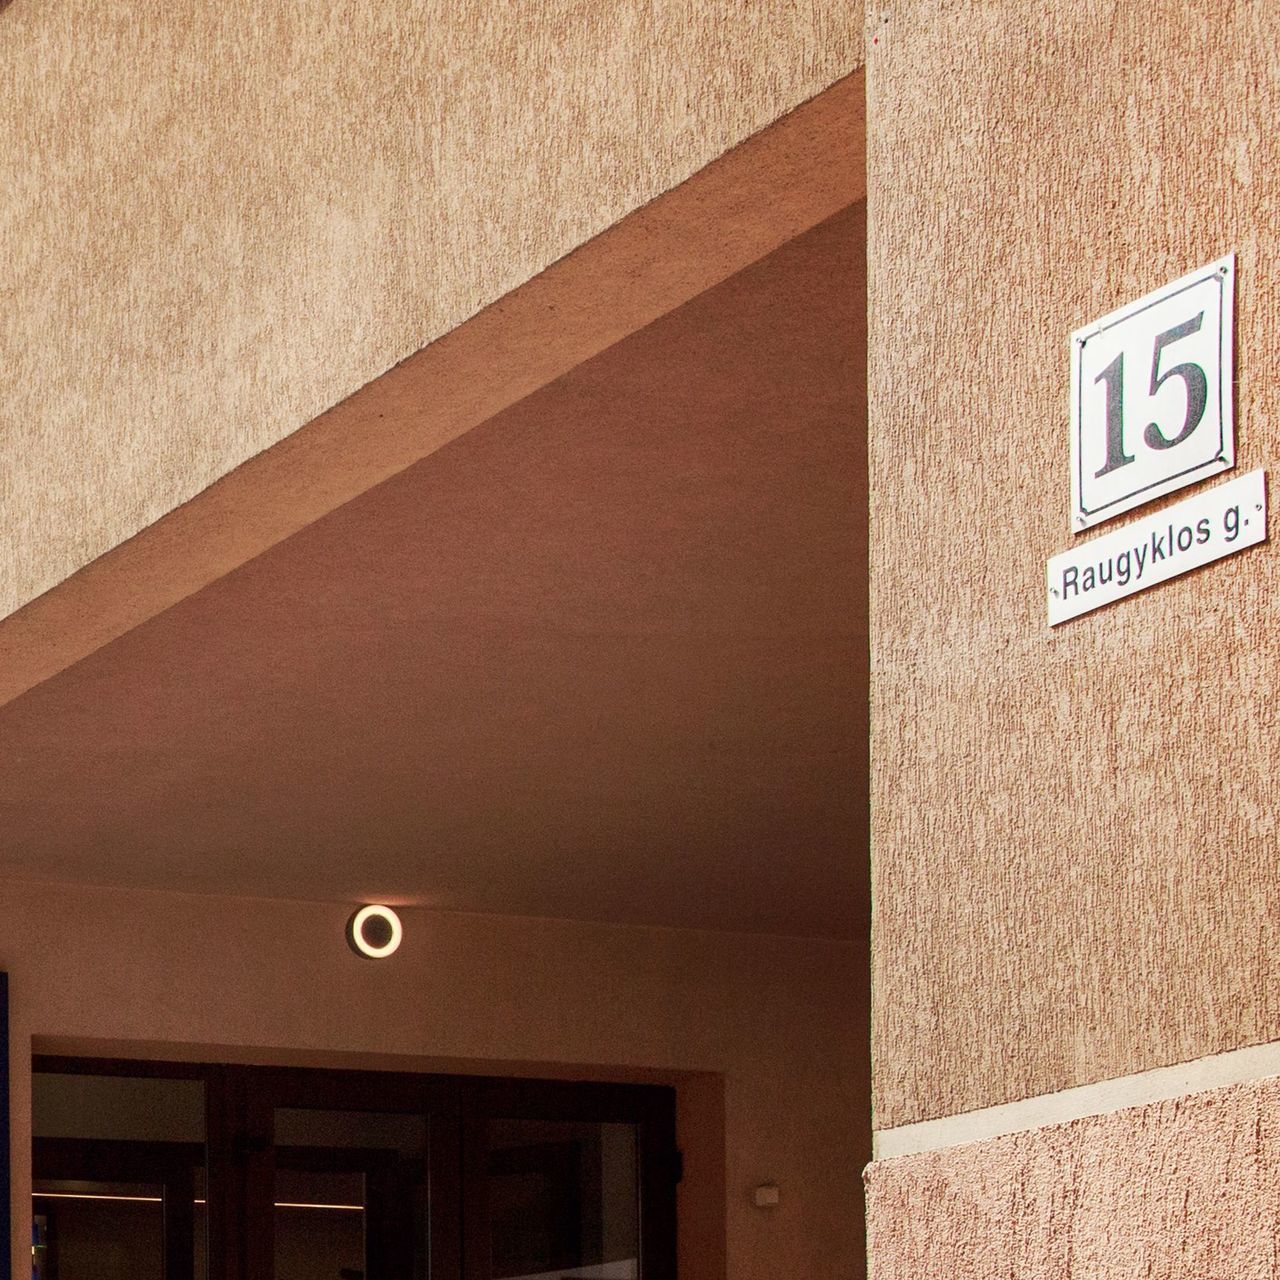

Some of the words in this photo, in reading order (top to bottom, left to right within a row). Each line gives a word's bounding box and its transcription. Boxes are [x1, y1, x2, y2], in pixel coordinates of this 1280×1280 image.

[1094, 309, 1208, 479] 15
[1062, 517, 1211, 601] Raugyklos
[1223, 504, 1250, 542] g.
